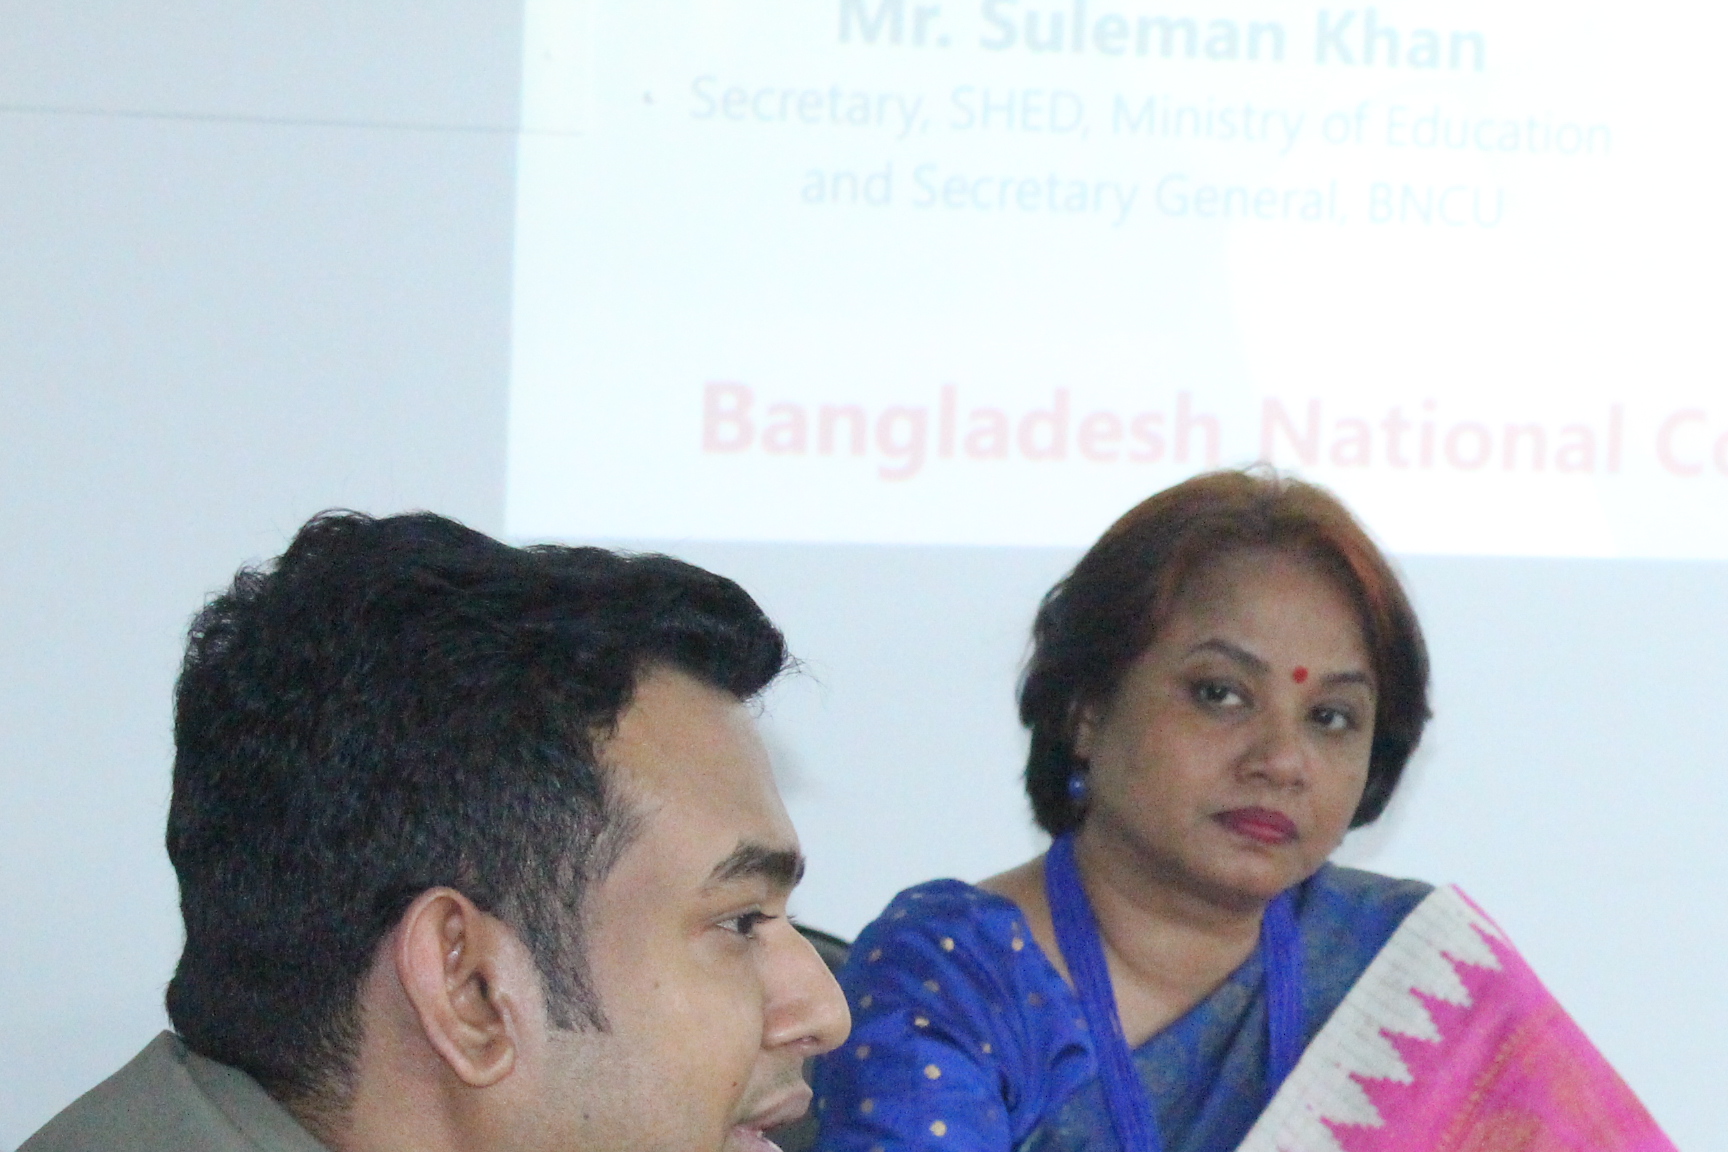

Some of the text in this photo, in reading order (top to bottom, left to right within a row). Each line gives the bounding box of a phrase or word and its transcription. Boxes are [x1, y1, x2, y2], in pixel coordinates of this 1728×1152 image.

[837, 0, 1487, 72] Mr. Suleman Khan
[690, 74, 1613, 157] Secretary, SHED, Ministry of Education
[801, 162, 1505, 229] and Secretary General, BNCU
[700, 380, 1222, 480] Bangladesh
[1259, 396, 1625, 475] National
